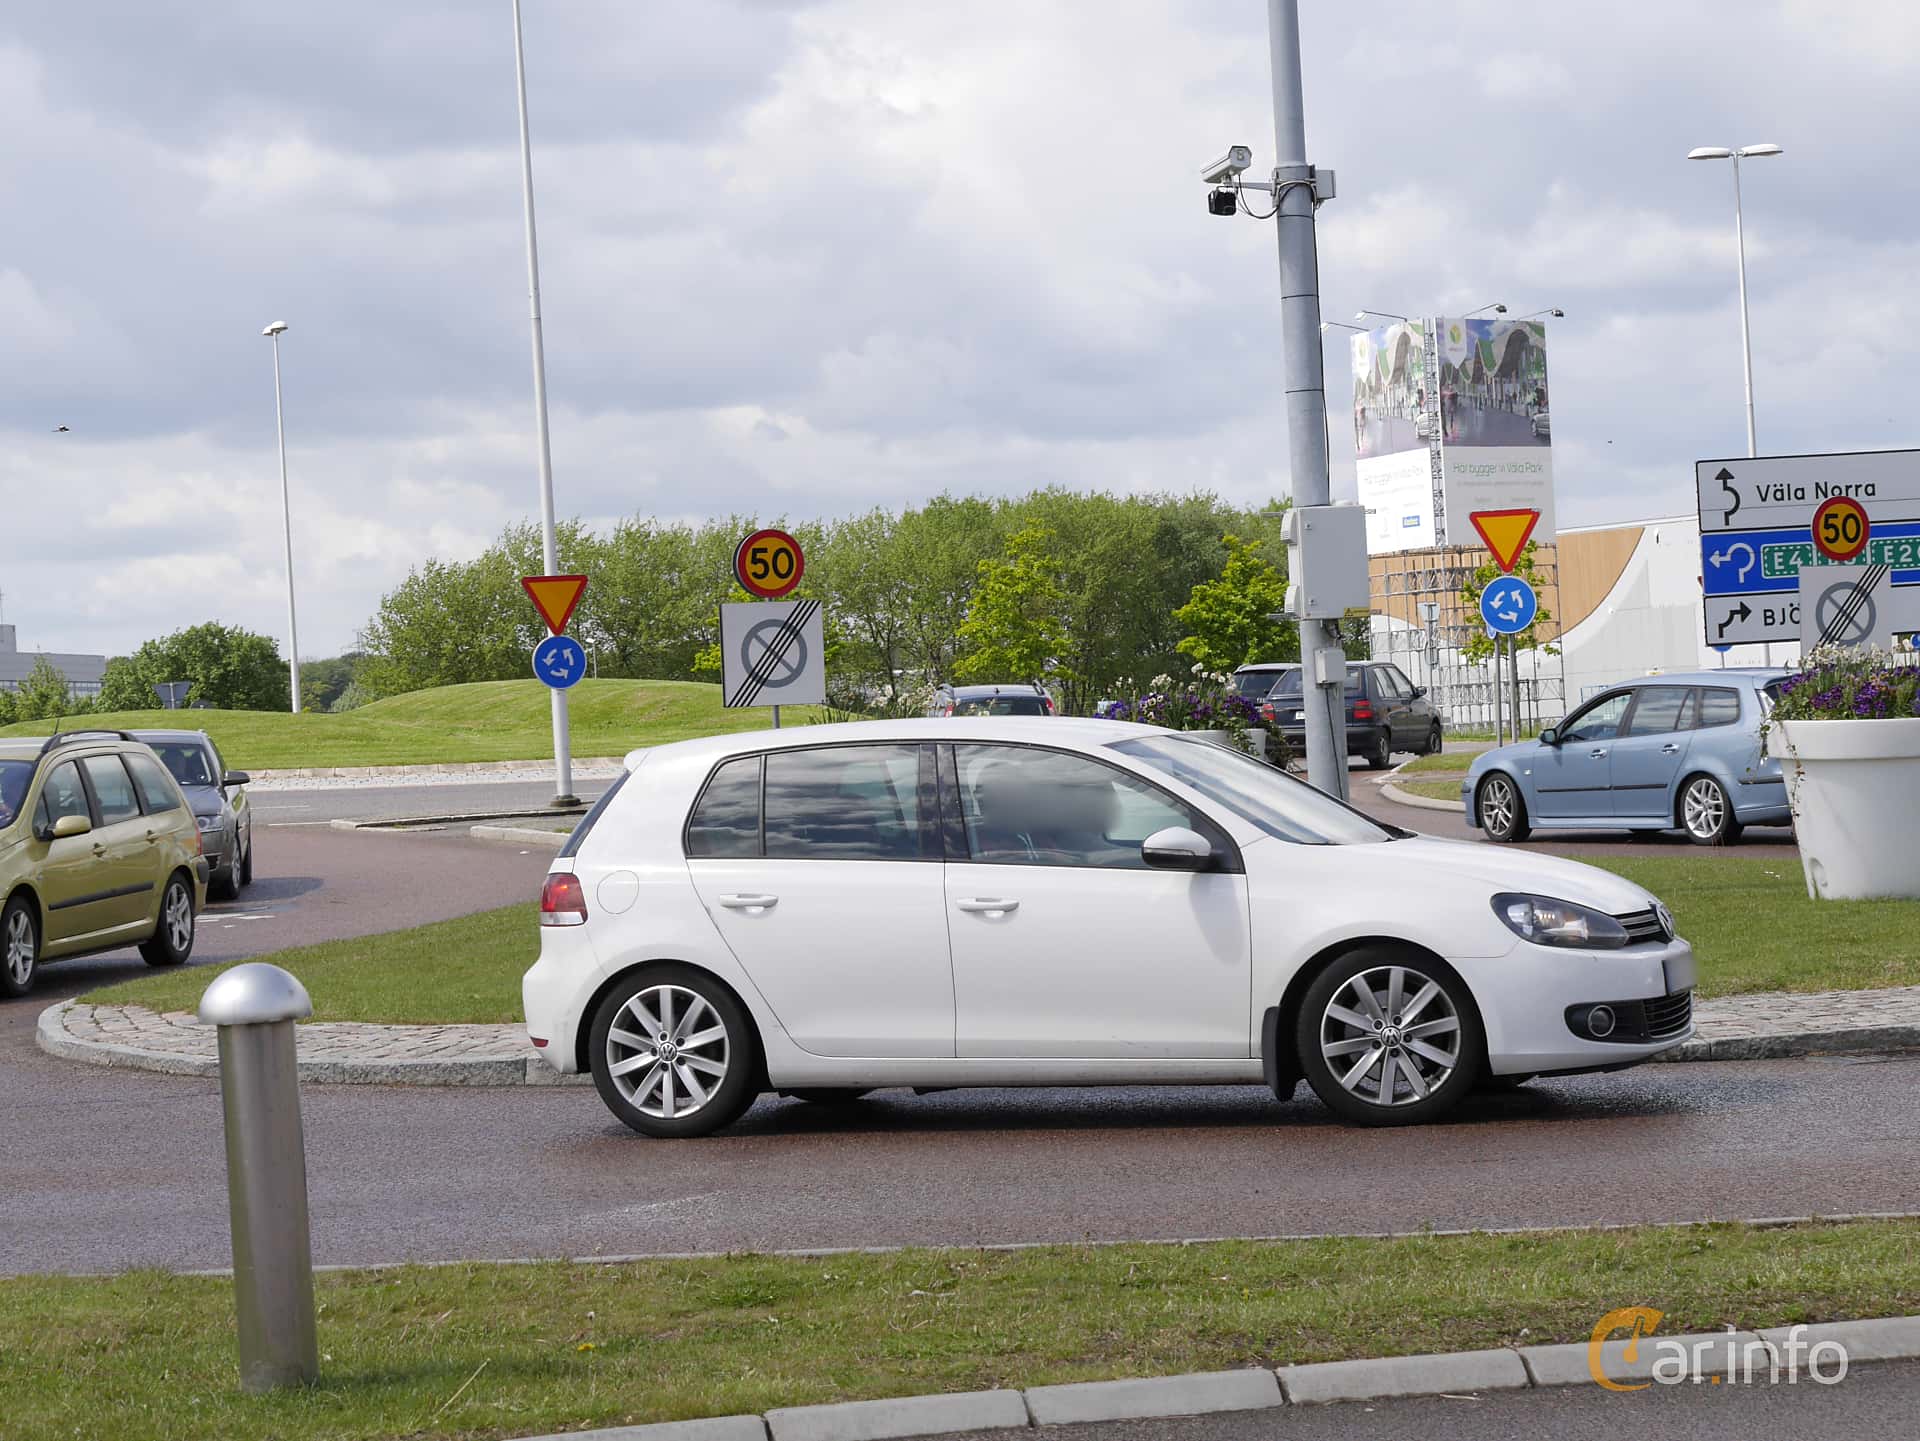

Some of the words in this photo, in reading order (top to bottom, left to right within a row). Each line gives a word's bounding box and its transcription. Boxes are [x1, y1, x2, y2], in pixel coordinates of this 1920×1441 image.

[1756, 483, 1806, 502] Väla
[1815, 481, 1876, 500] Norra
[1823, 513, 1861, 544] 50
[750, 547, 794, 580] 50
[1774, 551, 1803, 570] E4
[1884, 544, 1920, 563] E2
